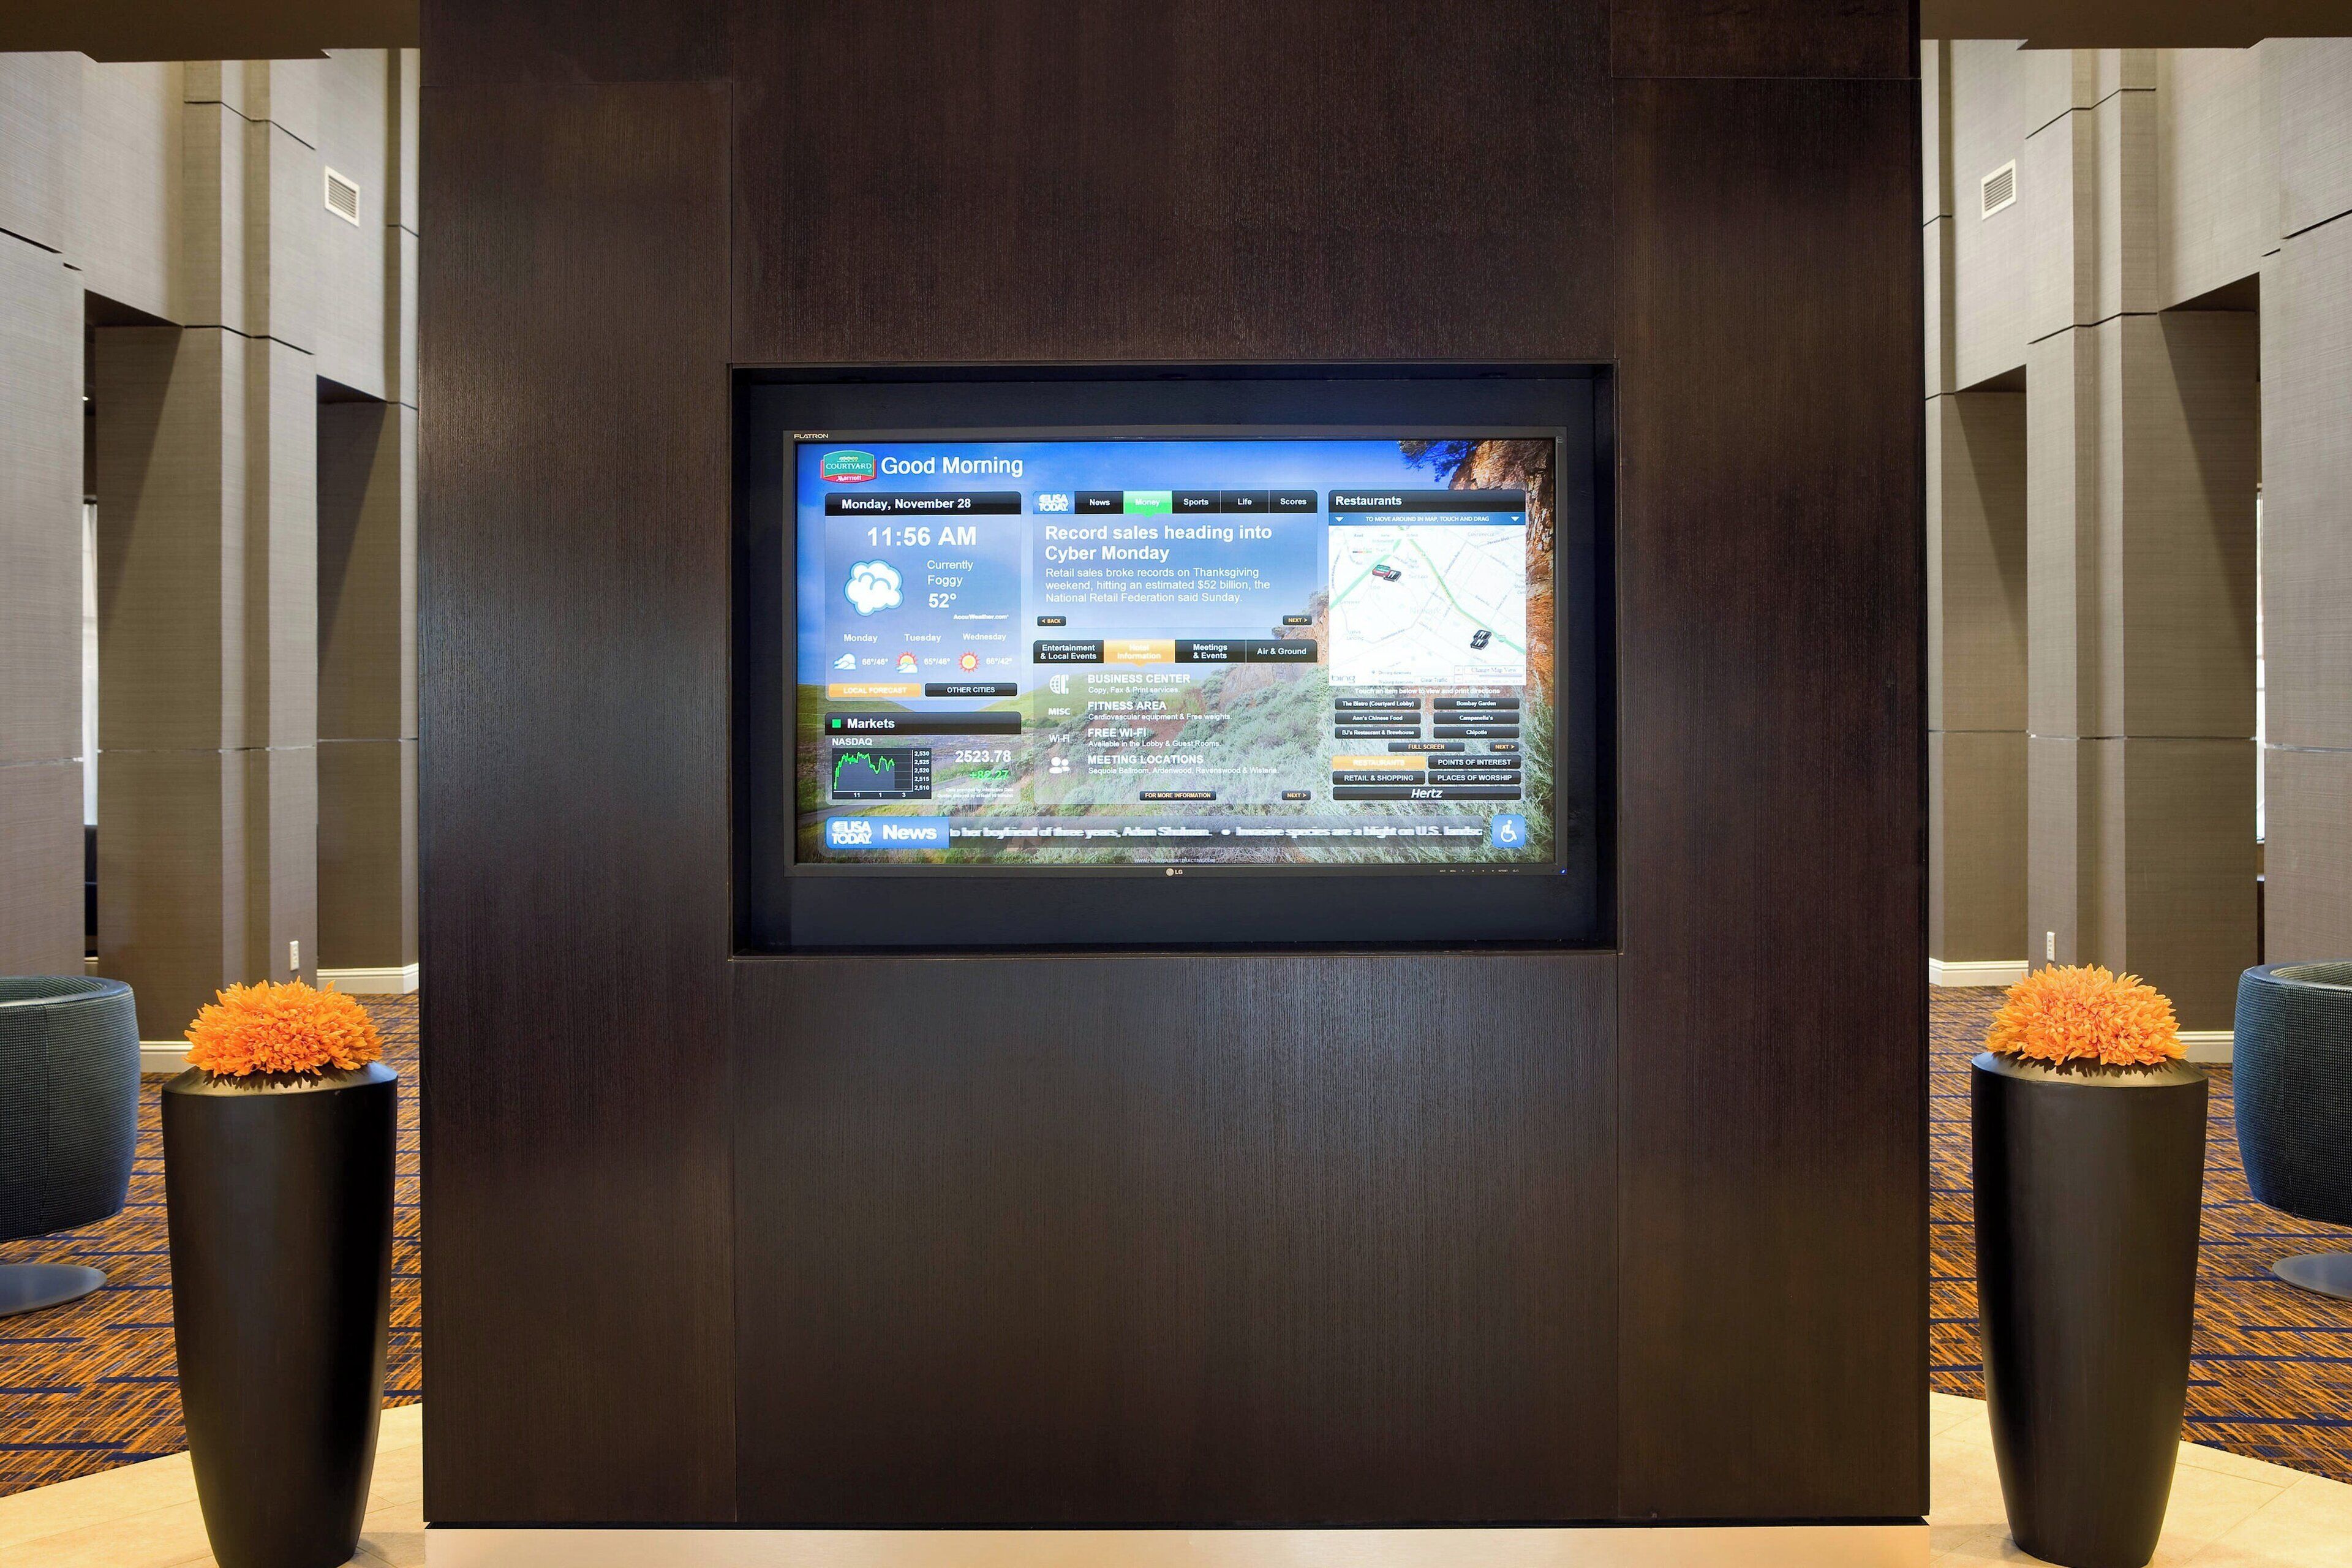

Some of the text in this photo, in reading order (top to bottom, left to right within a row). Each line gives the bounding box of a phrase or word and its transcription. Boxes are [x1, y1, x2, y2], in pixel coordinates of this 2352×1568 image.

[881, 456, 1023, 478] Good Morning
[842, 499, 971, 511] Monday, November 28
[1135, 499, 1160, 508] Money
[1183, 498, 1209, 507] Sports
[1335, 496, 1402, 505] Restaurants
[867, 526, 976, 546] 11:56 AM
[1046, 526, 1272, 543] Record sales heading into
[1046, 546, 1169, 563] Cyber Monday
[927, 560, 973, 571] Currently
[1046, 568, 1074, 577] Retail
[1077, 568, 1103, 577] sales
[1106, 568, 1134, 577] broke
[1137, 568, 1174, 577] records
[1193, 568, 1259, 579] Thanksgiving
[927, 576, 962, 587] Foggy
[1046, 581, 1094, 591] weekend,
[1096, 581, 1127, 592] hitting
[1145, 581, 1195, 589] estimated
[1197, 580, 1216, 590] $52
[1219, 581, 1251, 590] billion,
[1254, 580, 1270, 589] the
[929, 593, 957, 608] 52°
[1046, 593, 1243, 604] National Retail Federation said Sunday.
[844, 634, 878, 643] Monday
[904, 634, 941, 643] Tuesday
[963, 633, 1006, 642] Wednesday
[1147, 674, 1190, 683] CENTER
[1088, 701, 1167, 710] FITNESS AREA
[847, 718, 895, 729] Markets
[1088, 728, 1147, 737] FREE WI-FI
[955, 750, 1011, 763] 2523.78
[1140, 755, 1204, 764] LOCATIONS
[970, 770, 1009, 780] +82.27
[1411, 790, 1443, 798] Hertz
[883, 824, 937, 840] News
